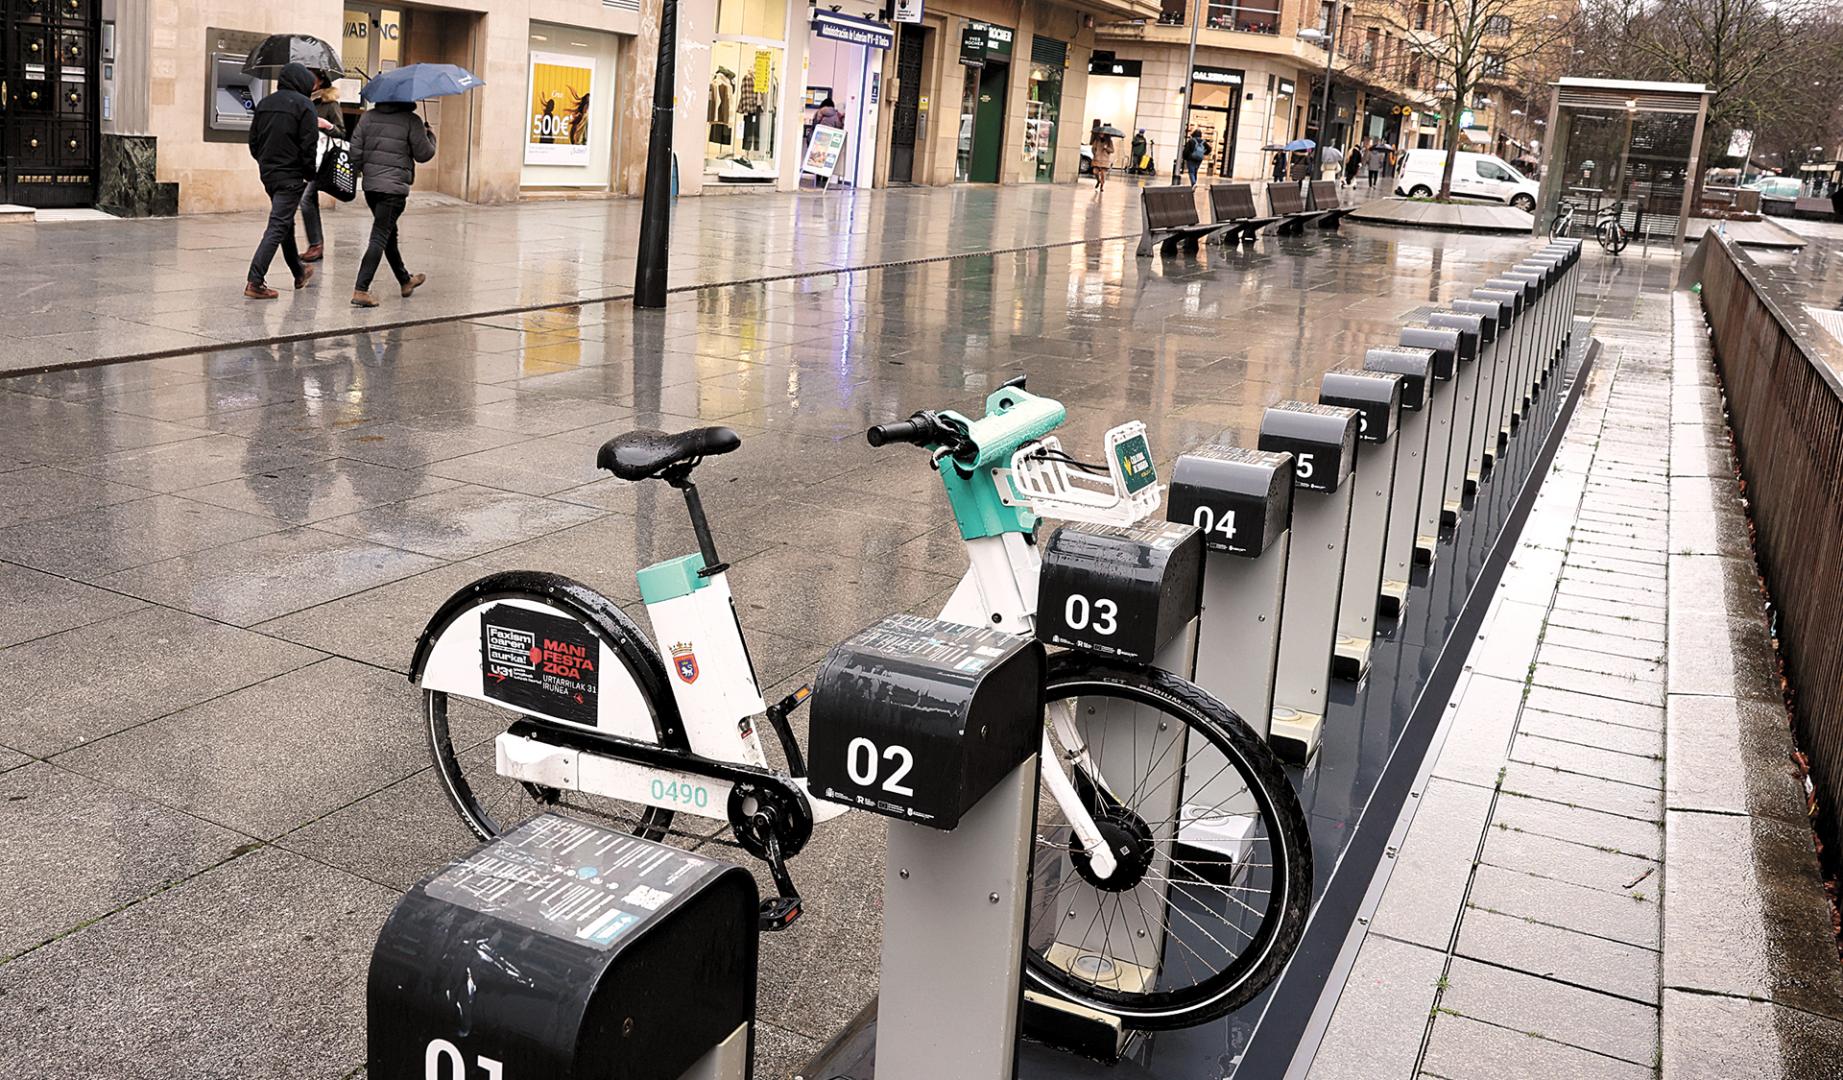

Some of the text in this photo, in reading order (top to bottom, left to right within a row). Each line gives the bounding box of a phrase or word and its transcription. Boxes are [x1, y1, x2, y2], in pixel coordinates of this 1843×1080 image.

[1296, 453, 1314, 478] 5
[1193, 505, 1237, 539] 04
[1065, 593, 1118, 635] 03
[490, 628, 532, 644] Faxism
[490, 637, 525, 649] oaren
[491, 651, 527, 664] aurka!
[543, 639, 586, 657] MANI
[543, 650, 594, 671] FESTA
[543, 661, 581, 679] ZIOA
[491, 664, 513, 678] U31
[542, 674, 586, 691] URTARRILAK
[587, 684, 597, 694] 31
[847, 737, 914, 797] 02
[651, 779, 708, 807] 0490
